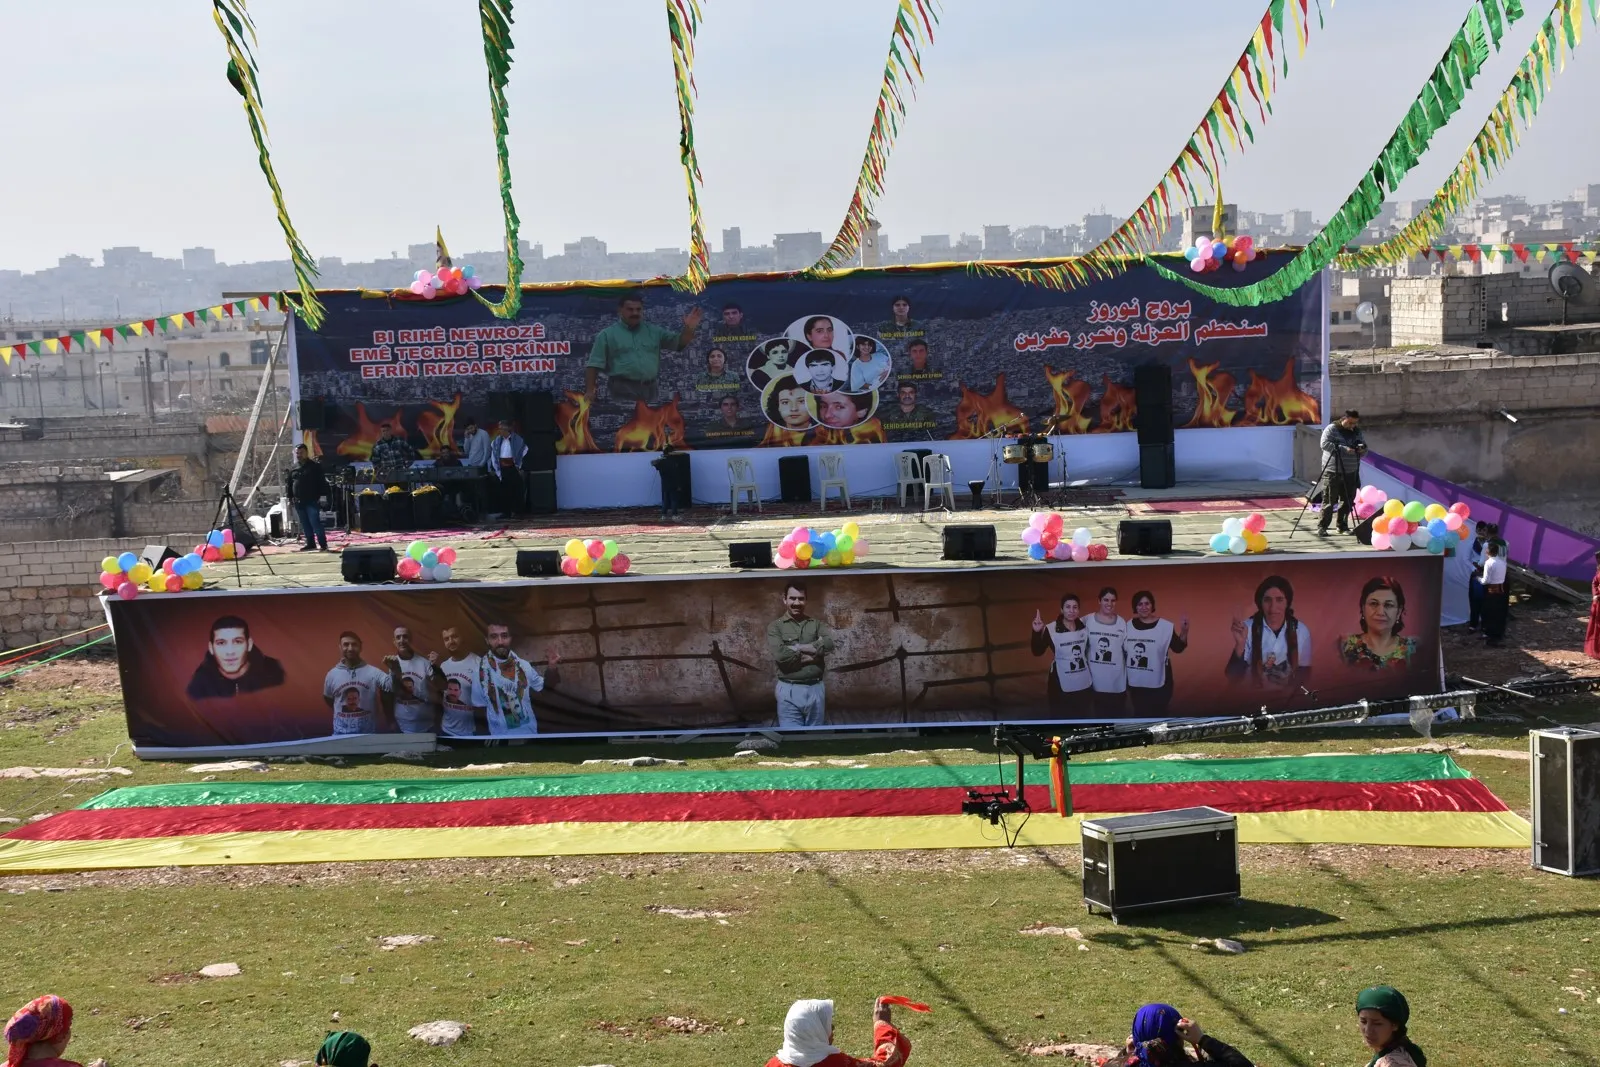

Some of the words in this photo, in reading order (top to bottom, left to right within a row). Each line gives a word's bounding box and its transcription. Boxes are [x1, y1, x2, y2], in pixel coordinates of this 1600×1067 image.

[1086, 297, 1140, 324] نوروز
[1145, 299, 1192, 321] بروح
[373, 330, 393, 344] BI
[398, 326, 445, 343] RIHÊ
[450, 322, 545, 342] NEWROZÊ
[1014, 326, 1071, 352] عفرين
[1074, 324, 1128, 350] ونحرر
[1131, 320, 1190, 346] العزلة
[1195, 319, 1268, 346] سنحطم
[349, 346, 391, 362] EMÊ
[395, 342, 479, 361] TECRÎDÊ
[482, 340, 571, 361] BIŞKÎNIN
[424, 360, 498, 377] RIZGAR
[501, 357, 556, 374] BIKIN
